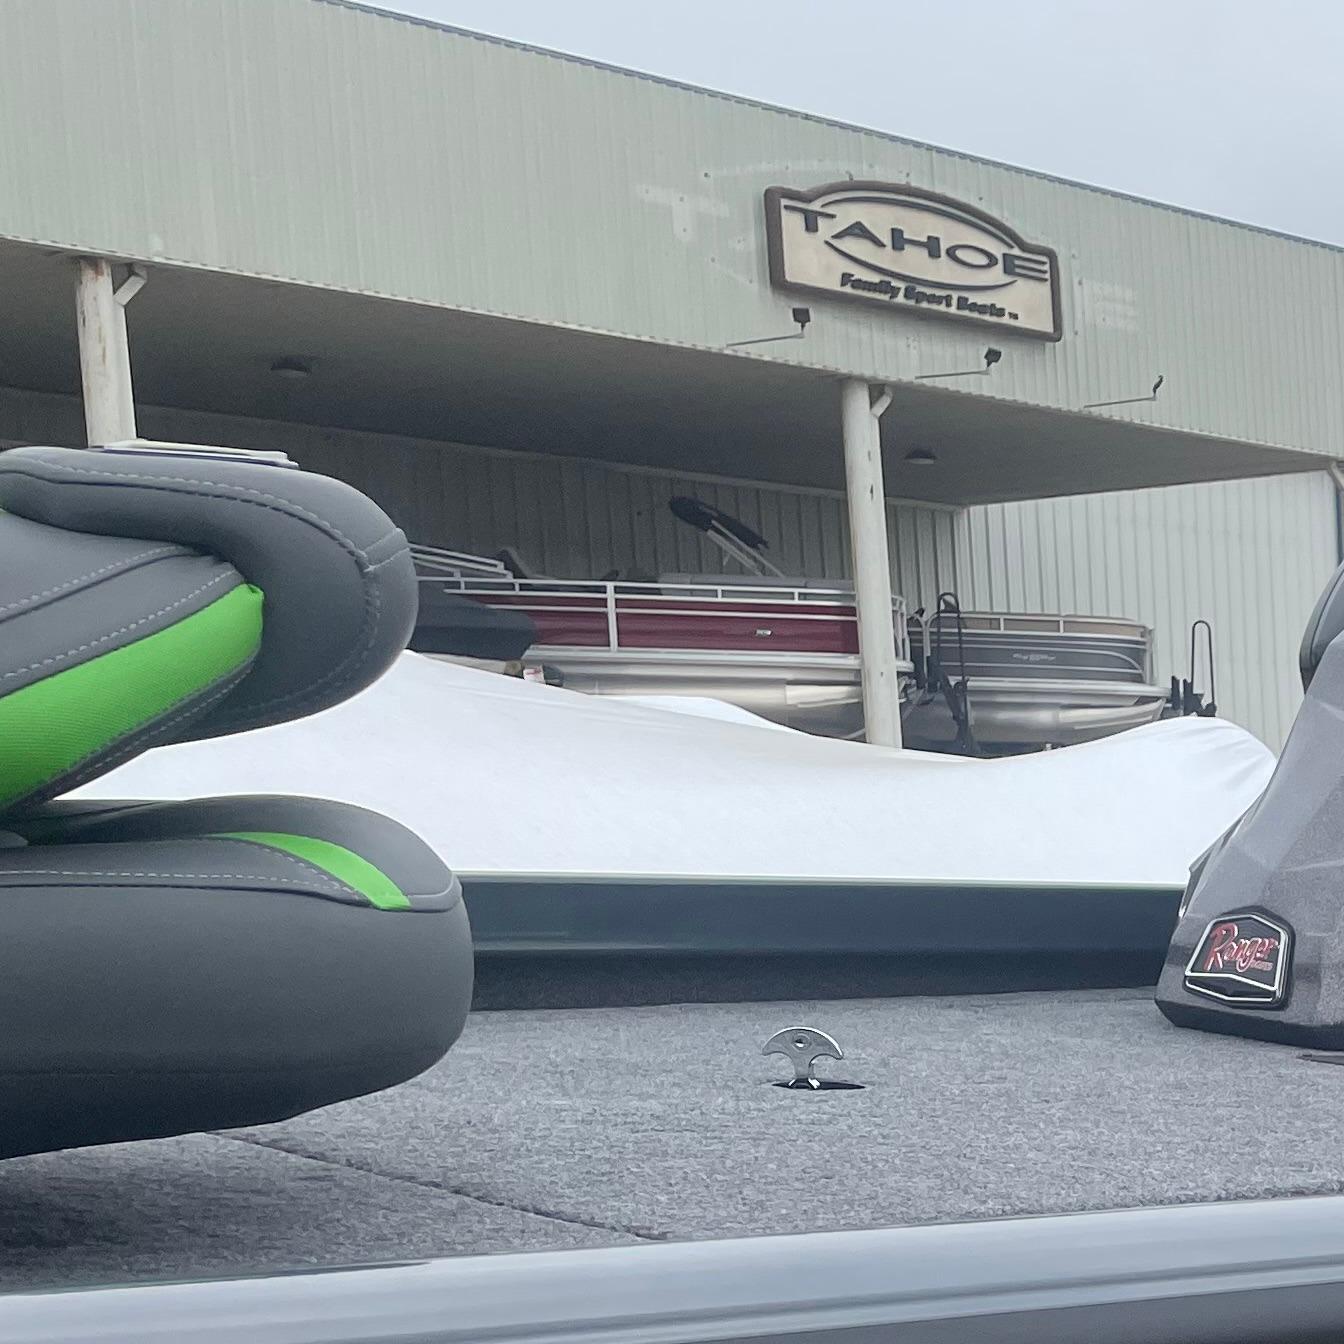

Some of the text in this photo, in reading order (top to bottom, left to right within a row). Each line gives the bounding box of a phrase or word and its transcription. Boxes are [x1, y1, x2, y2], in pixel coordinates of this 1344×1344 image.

[783, 203, 1049, 283] TAHOE
[840, 272, 901, 300] Family
[904, 285, 953, 308] Sport
[956, 295, 1006, 318] Boats
[1203, 922, 1281, 973] Ranger
